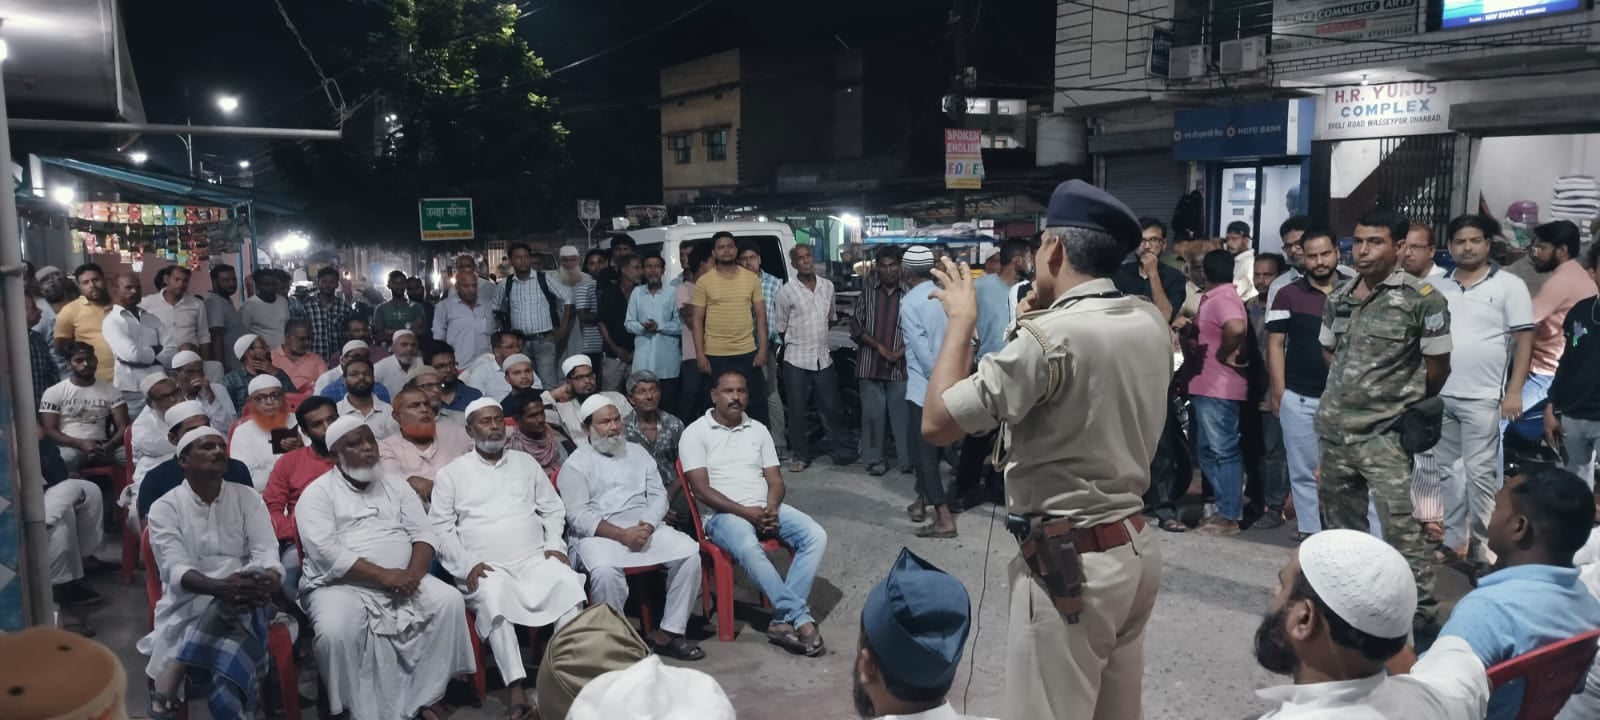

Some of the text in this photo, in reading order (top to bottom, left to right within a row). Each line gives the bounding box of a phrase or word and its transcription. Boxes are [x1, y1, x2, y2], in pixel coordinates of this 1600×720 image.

[1318, 2, 1377, 18] COMMERCE
[1335, 88, 1365, 103] H.R.
[1341, 98, 1430, 118] COMPLEX
[1347, 120, 1365, 129] ROAD
[1368, 116, 1408, 127] WASSEYPUR
[1409, 114, 1441, 123] DHANBAD
[947, 129, 980, 140] SPOKEN
[1238, 124, 1281, 135] HDFC BANK
[947, 143, 981, 153] ENGLISH
[948, 162, 979, 175] EDGE
